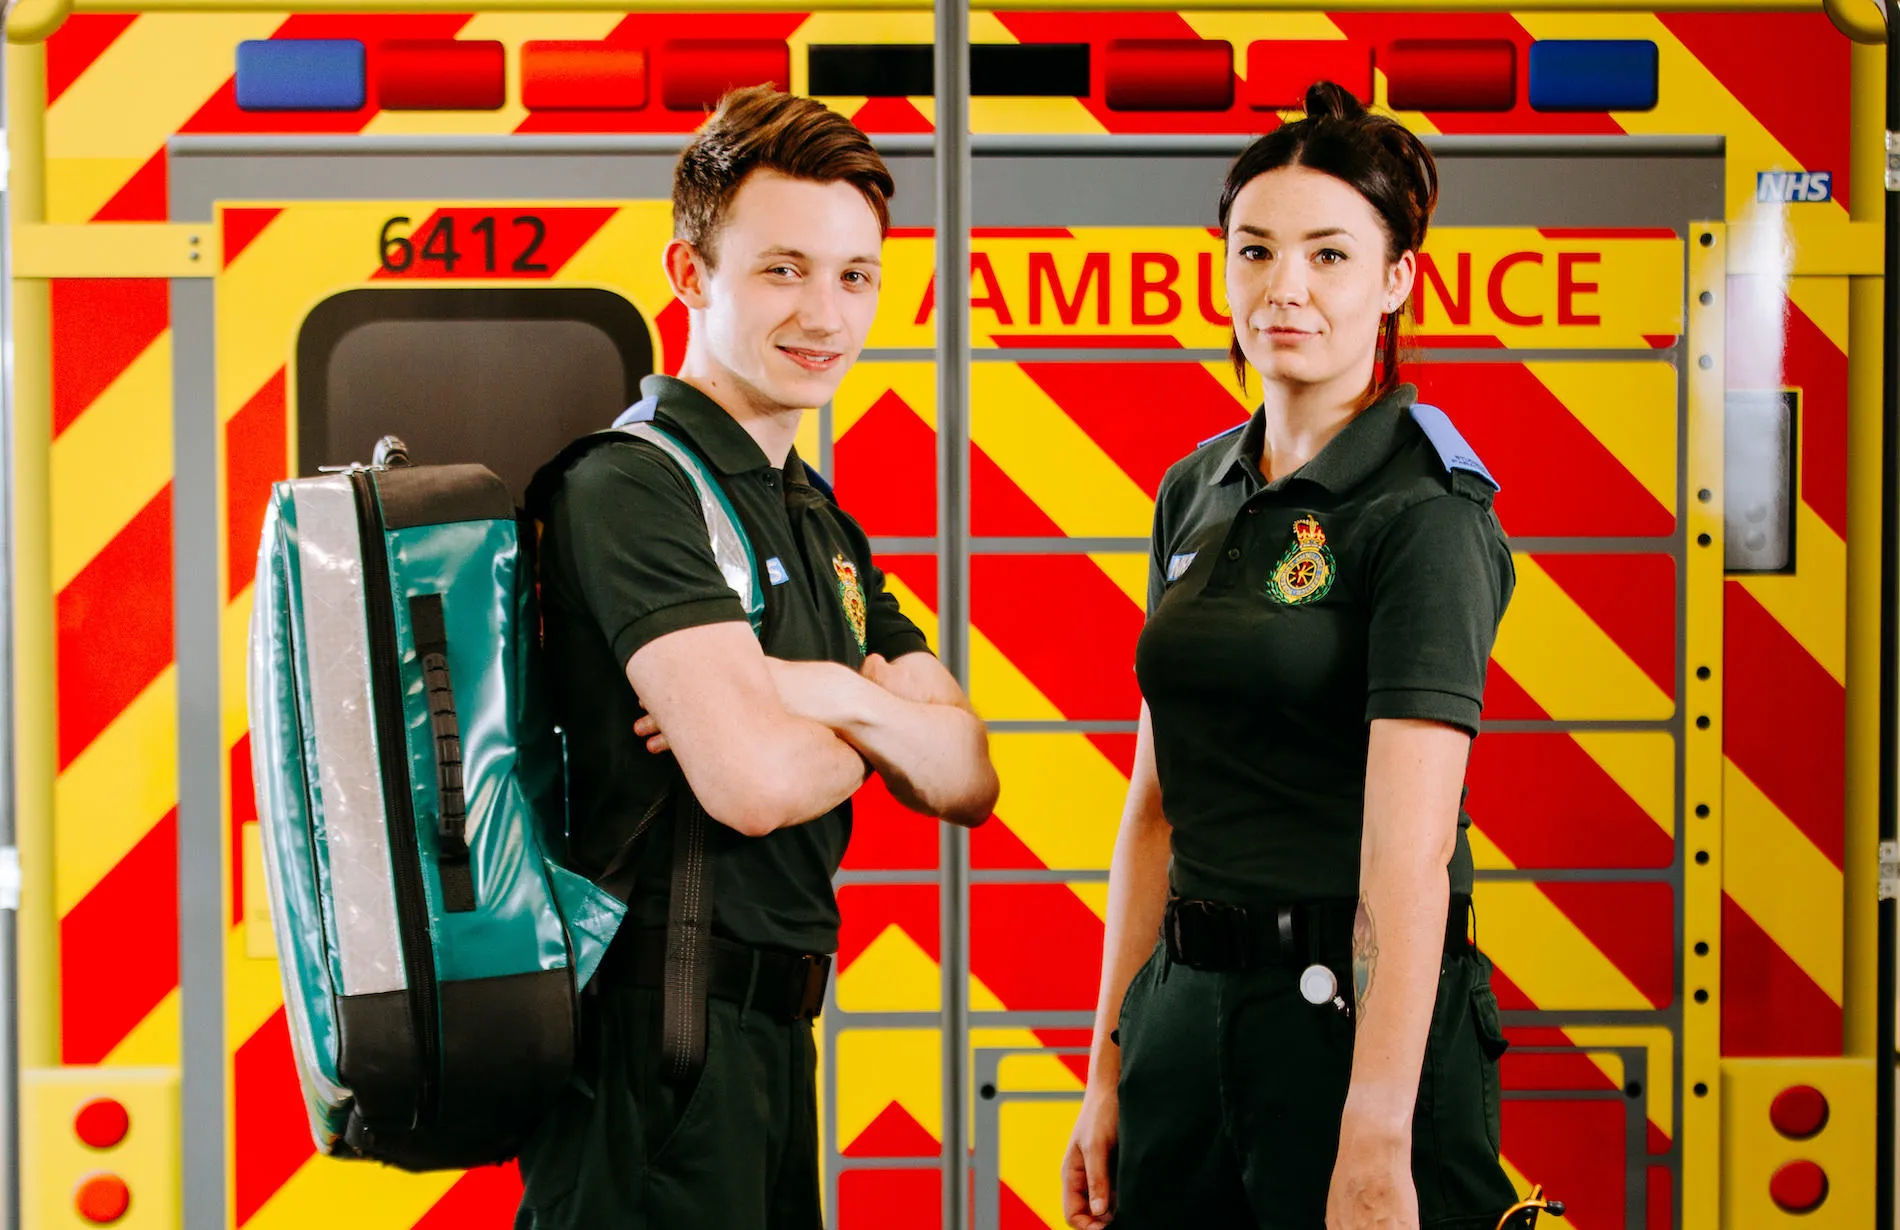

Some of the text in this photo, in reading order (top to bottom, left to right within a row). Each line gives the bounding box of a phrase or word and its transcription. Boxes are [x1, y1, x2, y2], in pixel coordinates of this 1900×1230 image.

[1759, 172, 1829, 201] NHS
[379, 215, 549, 273] 6412
[914, 251, 1601, 327] AMBUNCE
